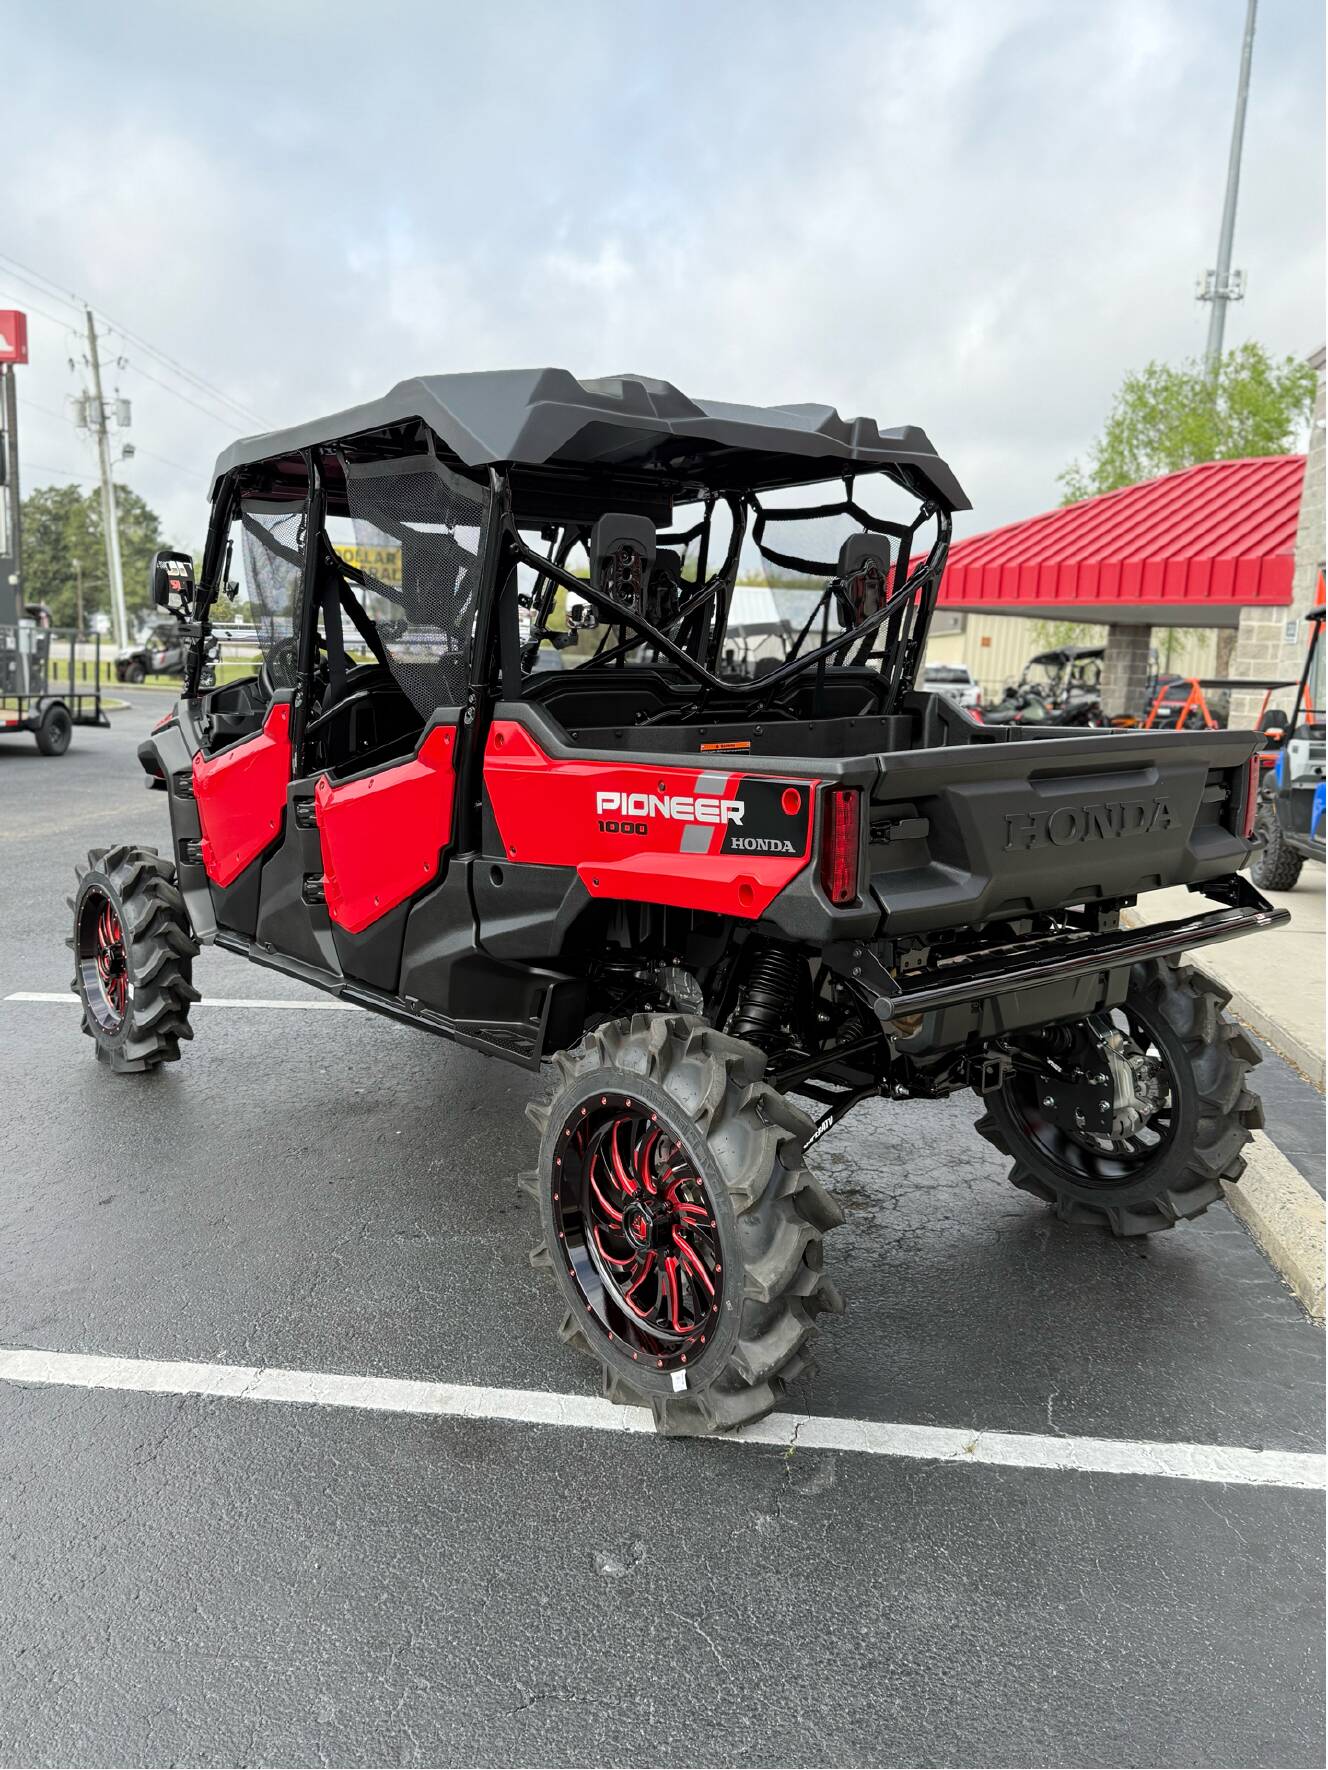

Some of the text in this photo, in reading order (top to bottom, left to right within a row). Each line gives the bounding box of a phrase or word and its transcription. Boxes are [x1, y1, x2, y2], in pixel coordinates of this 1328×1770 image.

[597, 791, 745, 826] PIONEER
[598, 820, 648, 836] 1000
[1003, 797, 1182, 852] HONDA
[731, 837, 796, 853] HONDA
